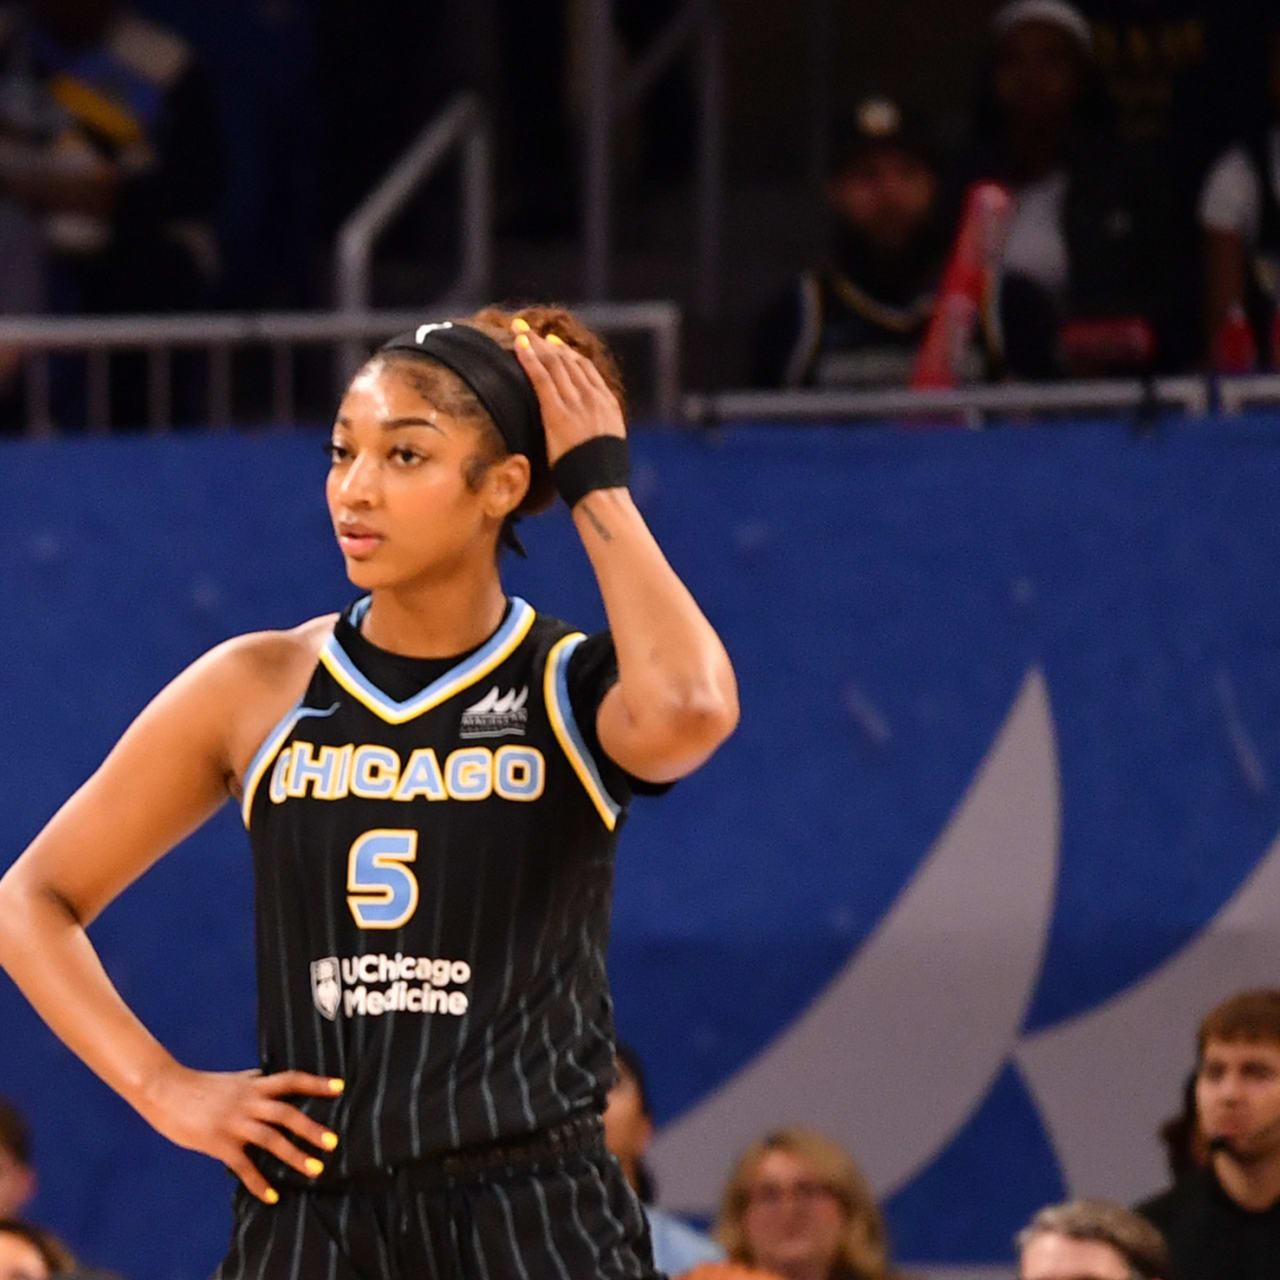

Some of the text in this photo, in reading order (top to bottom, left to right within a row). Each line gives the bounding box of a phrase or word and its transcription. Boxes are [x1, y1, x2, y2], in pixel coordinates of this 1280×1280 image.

[346, 828, 419, 930] 5
[342, 952, 471, 986] UChicago
[344, 981, 469, 1017] Medicine
